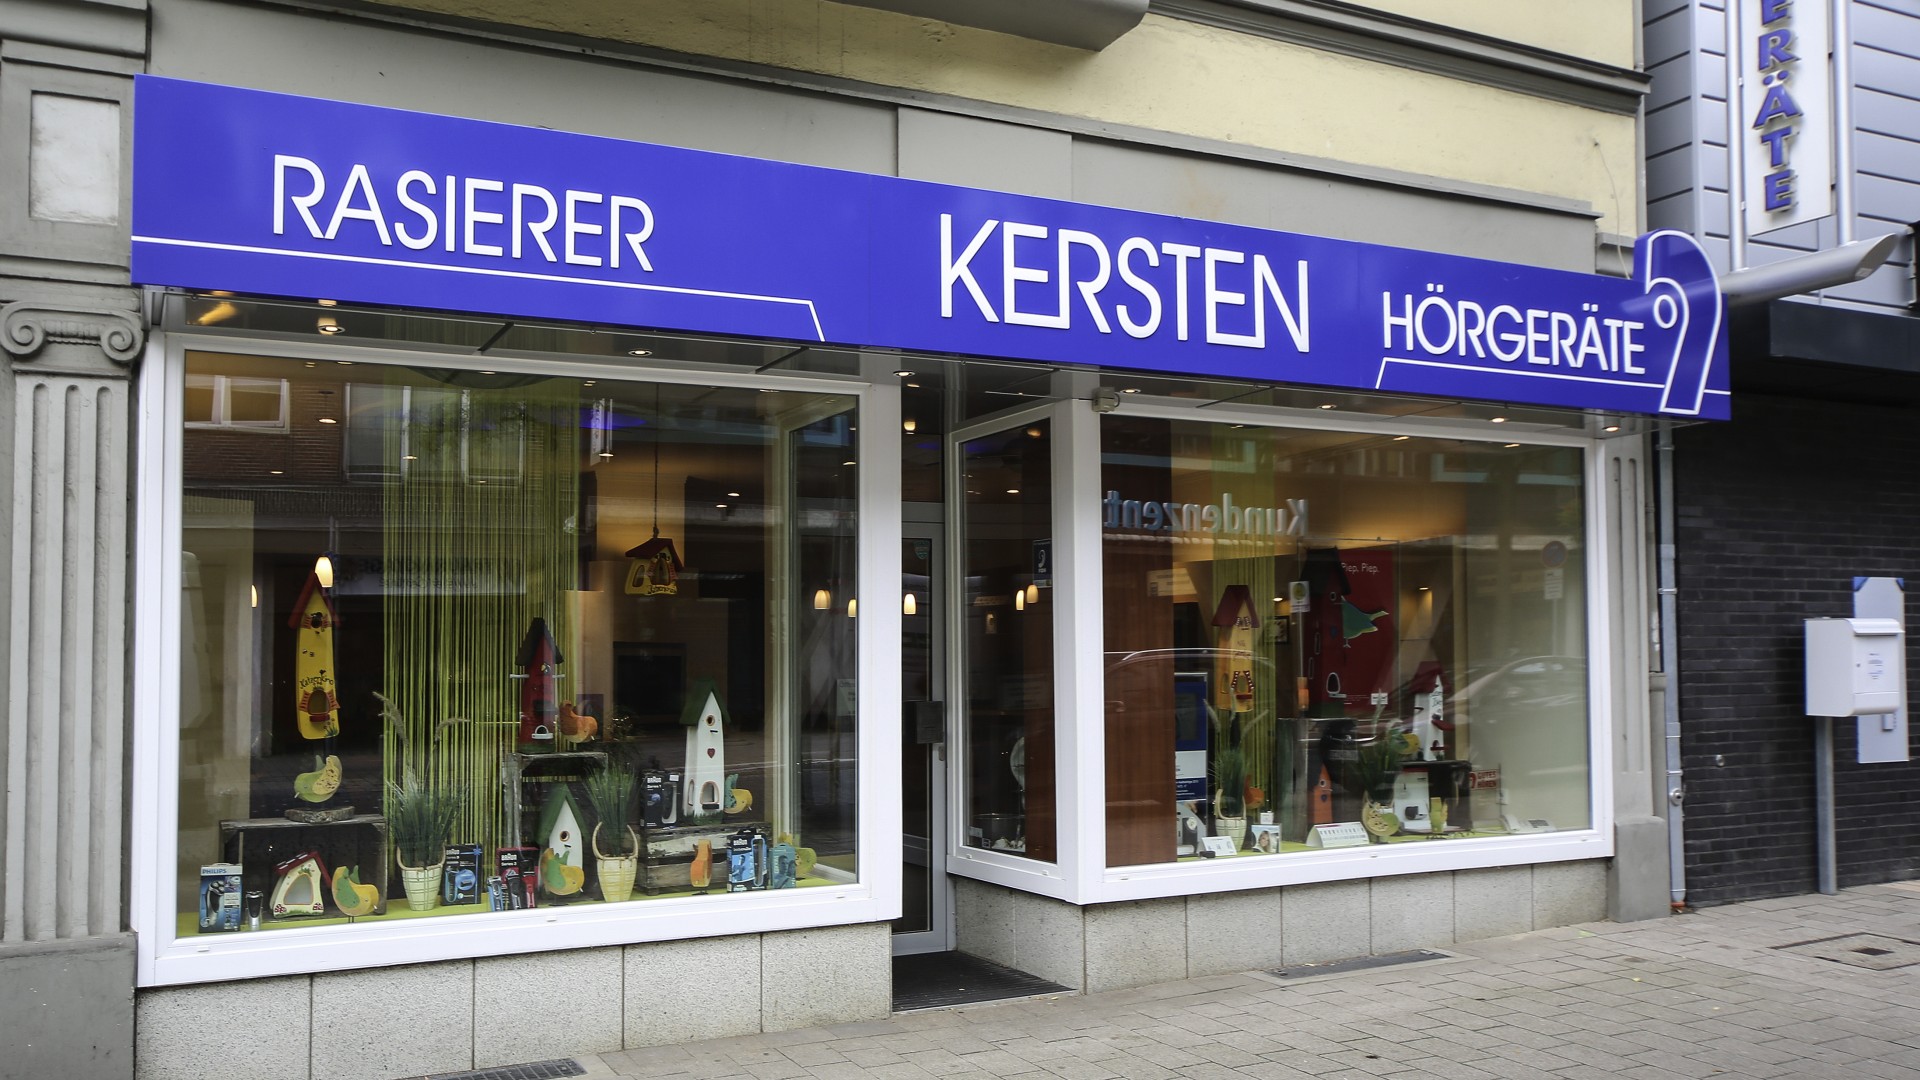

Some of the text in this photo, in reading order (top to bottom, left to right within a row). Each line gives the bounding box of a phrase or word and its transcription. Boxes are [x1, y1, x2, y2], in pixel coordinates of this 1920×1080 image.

[272, 154, 655, 272] RASIERER
[940, 213, 1310, 353] KERSTEN
[1382, 282, 1646, 375] HÖRGERÄTE
